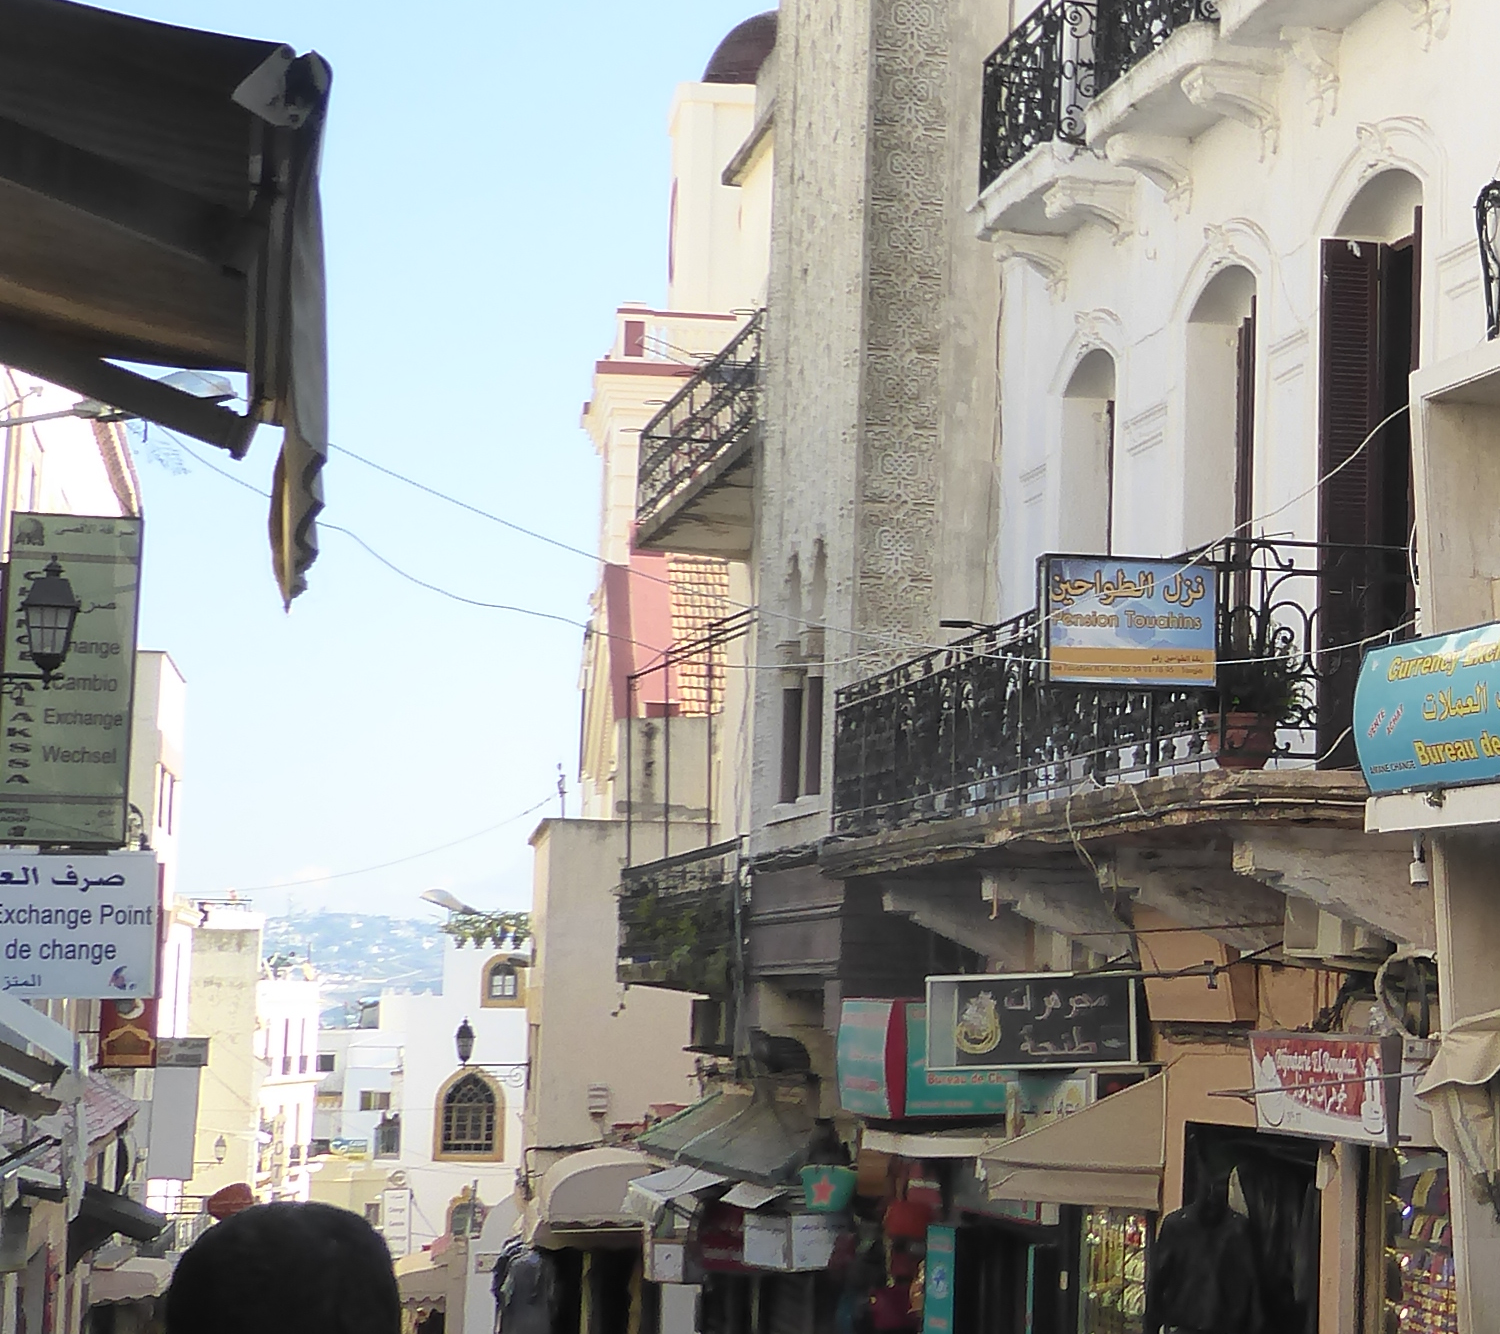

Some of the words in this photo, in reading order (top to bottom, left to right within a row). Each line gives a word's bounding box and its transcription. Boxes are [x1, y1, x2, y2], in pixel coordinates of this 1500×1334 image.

[1050, 568, 1154, 606] الطواحين
[1163, 571, 1205, 608] نزل
[1051, 609, 1119, 629] Pension
[1125, 610, 1202, 630] Touahins
[69, 640, 120, 659] hange
[1387, 651, 1459, 682] Currency
[1422, 680, 1489, 722] العملات
[43, 708, 123, 730] Exchange
[1367, 709, 1387, 739] VENTE
[42, 745, 117, 764] Wechsel
[1413, 739, 1479, 766] Bureau
[51, 865, 125, 892] صرف
[100, 904, 153, 926] Point
[5, 939, 31, 960] de
[39, 939, 117, 965] change
[1020, 1025, 1098, 1061] طنجة
[928, 1072, 967, 1086] Bureau
[971, 1072, 984, 1085] de
